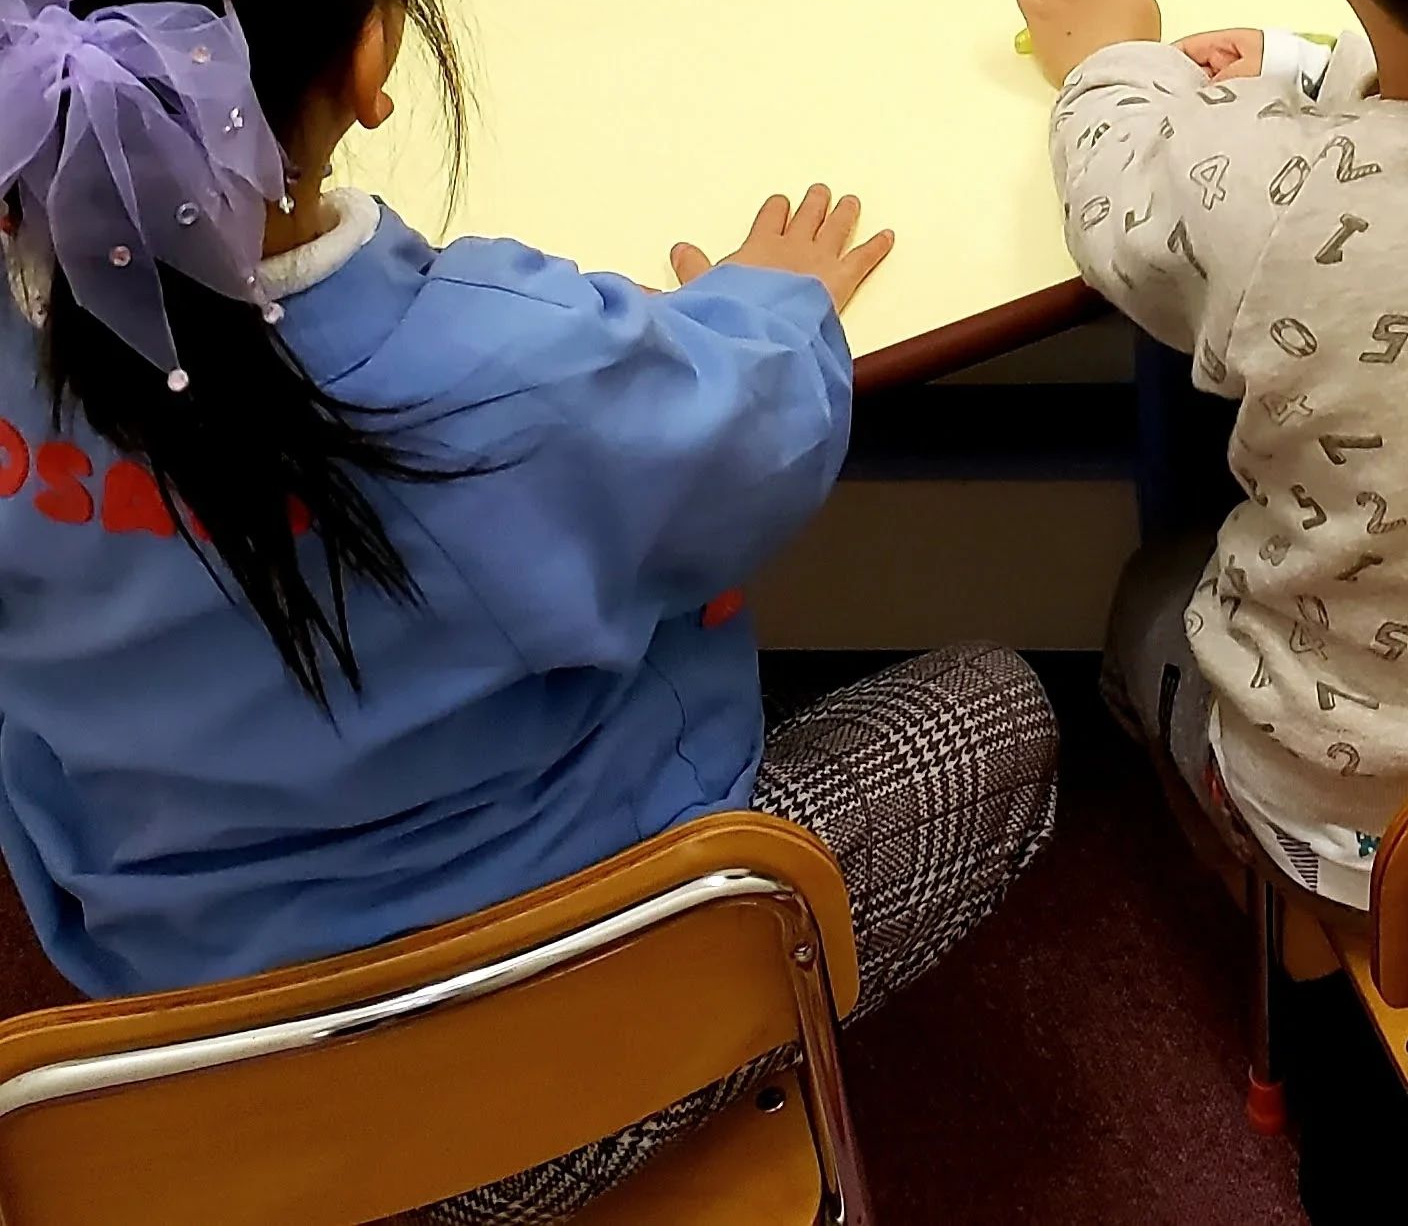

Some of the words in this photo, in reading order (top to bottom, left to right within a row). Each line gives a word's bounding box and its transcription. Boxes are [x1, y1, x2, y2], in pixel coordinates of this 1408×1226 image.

[1190, 154, 1231, 211] 4
[1269, 155, 1312, 206] 0
[1270, 317, 1318, 358] 0
[1355, 490, 1408, 536] 2
